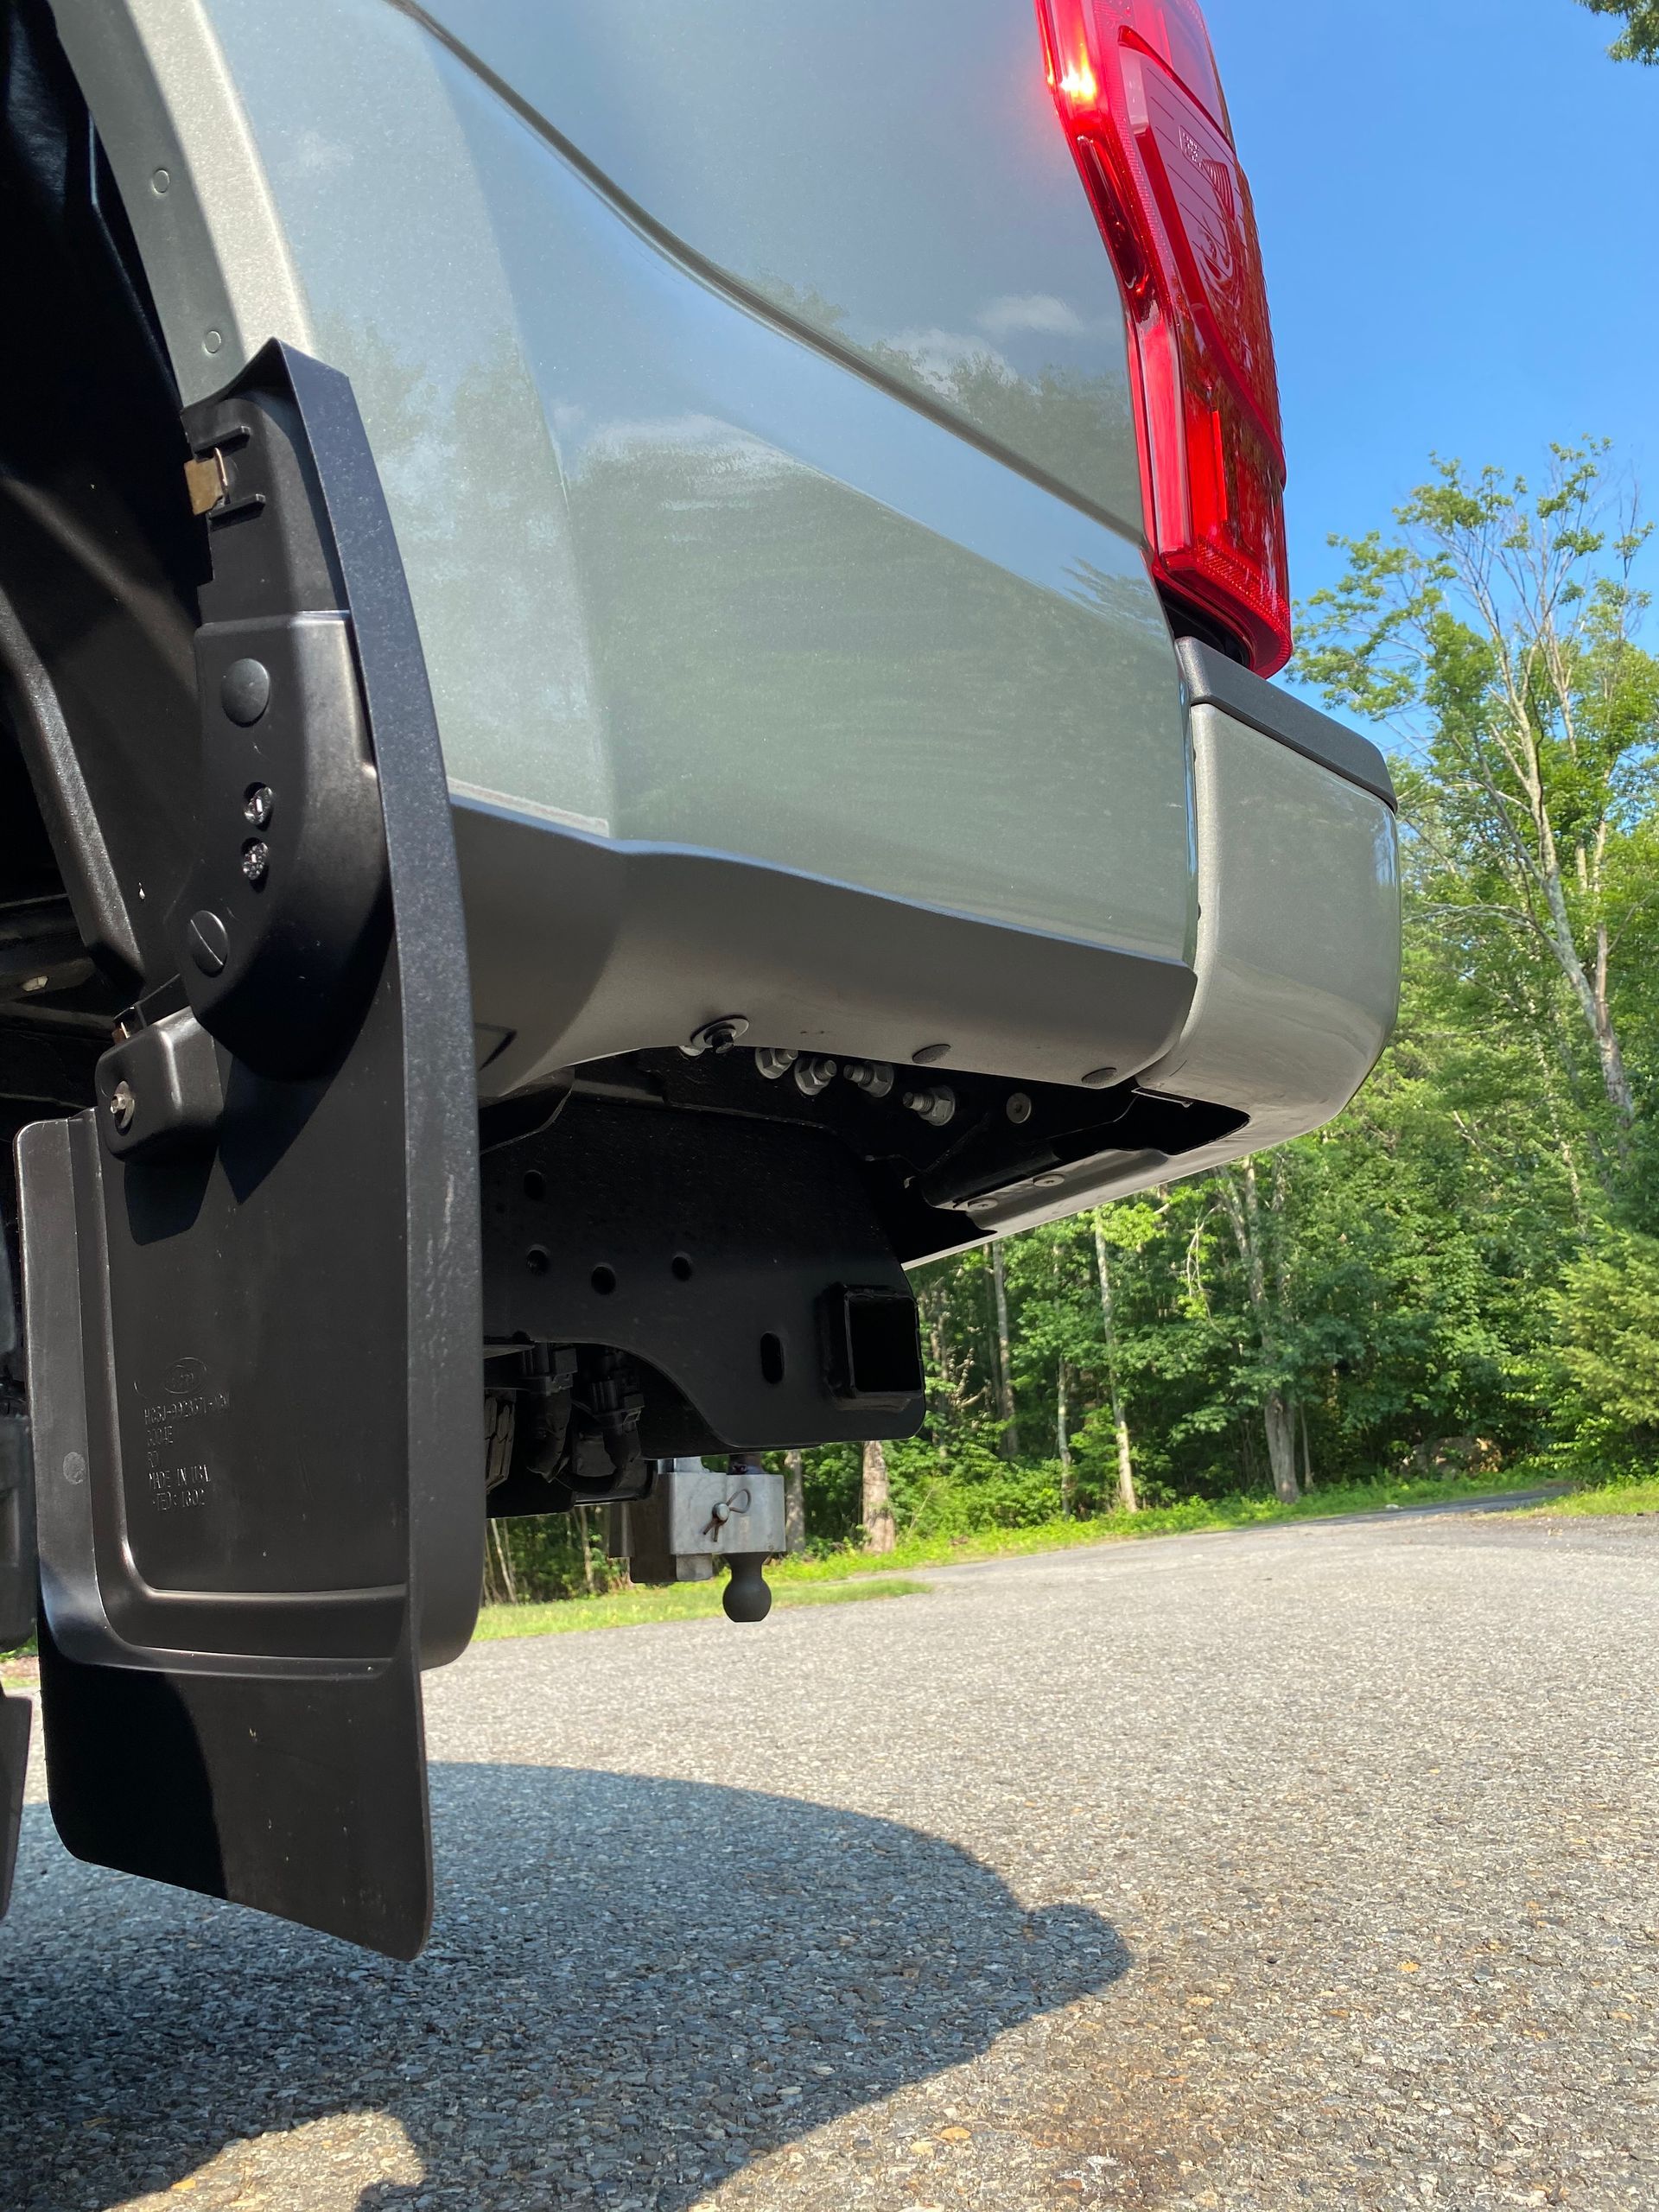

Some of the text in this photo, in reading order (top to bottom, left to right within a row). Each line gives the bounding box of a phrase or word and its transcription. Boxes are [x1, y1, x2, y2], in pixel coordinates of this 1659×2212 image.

[149, 1464, 212, 1489] MADE IN USA
